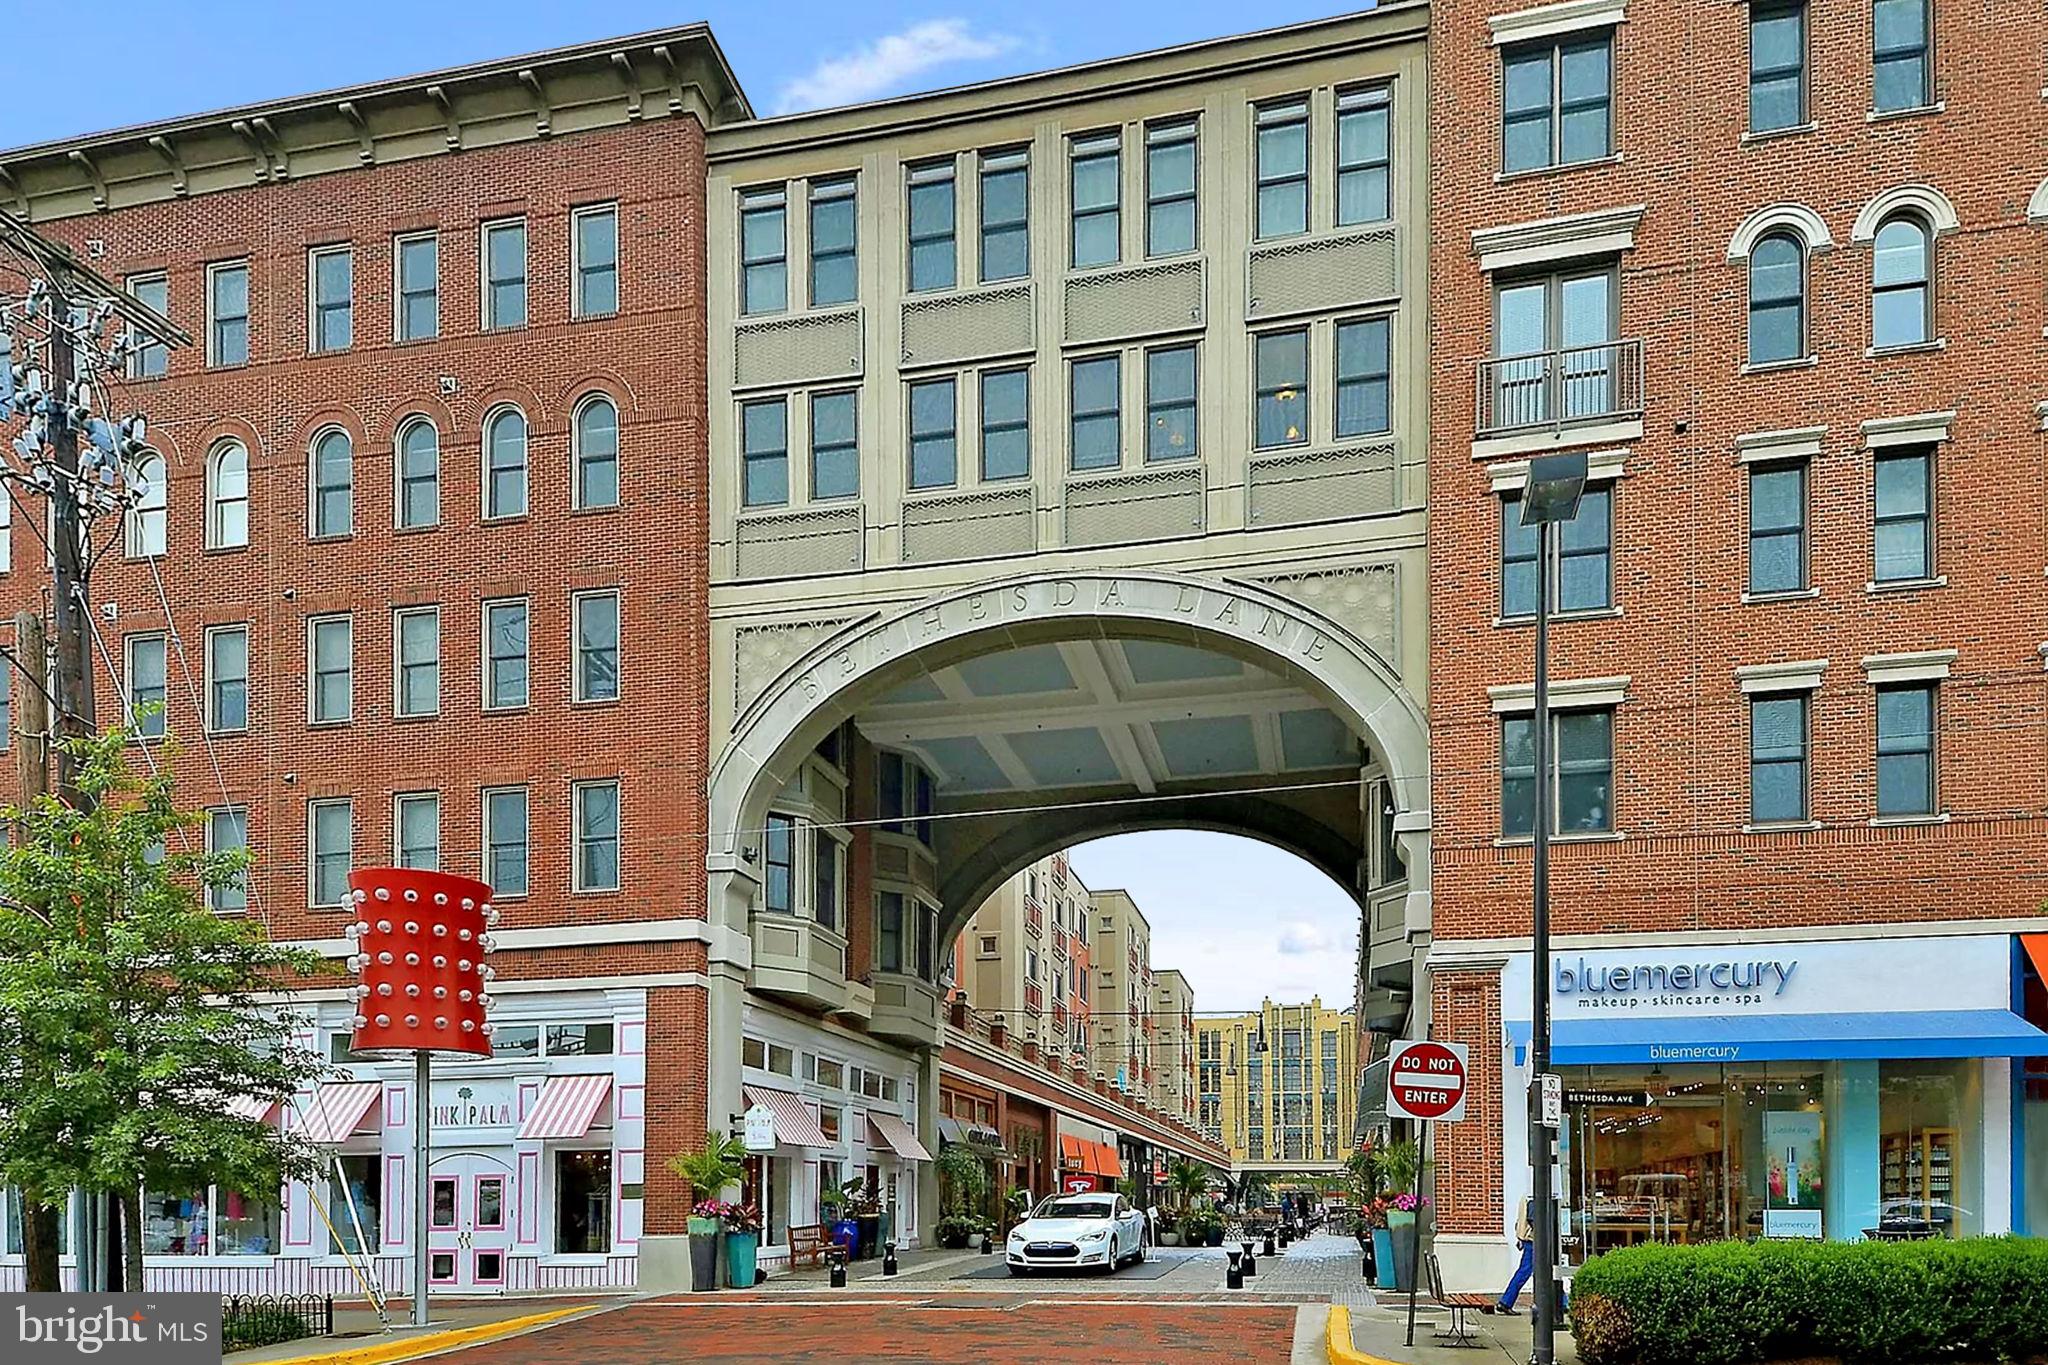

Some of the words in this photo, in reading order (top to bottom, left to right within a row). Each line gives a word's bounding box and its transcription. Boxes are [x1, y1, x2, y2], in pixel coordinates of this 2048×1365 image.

[796, 579, 1125, 703] BETHESDA
[1173, 584, 1331, 662] LANE
[1555, 956, 1799, 996] bluemercury
[1577, 995, 1639, 1009] makeup
[1652, 993, 1721, 1006] skincare
[1734, 994, 1762, 1005] spa
[1650, 1044, 1740, 1060] bluemercury
[1401, 1056, 1421, 1070] DO
[1428, 1057, 1456, 1072] NOT
[1404, 1089, 1448, 1105] ENTER
[1568, 1094, 1615, 1103] BETHESDA
[1616, 1094, 1634, 1103] AVE
[469, 1104, 511, 1126] PALM
